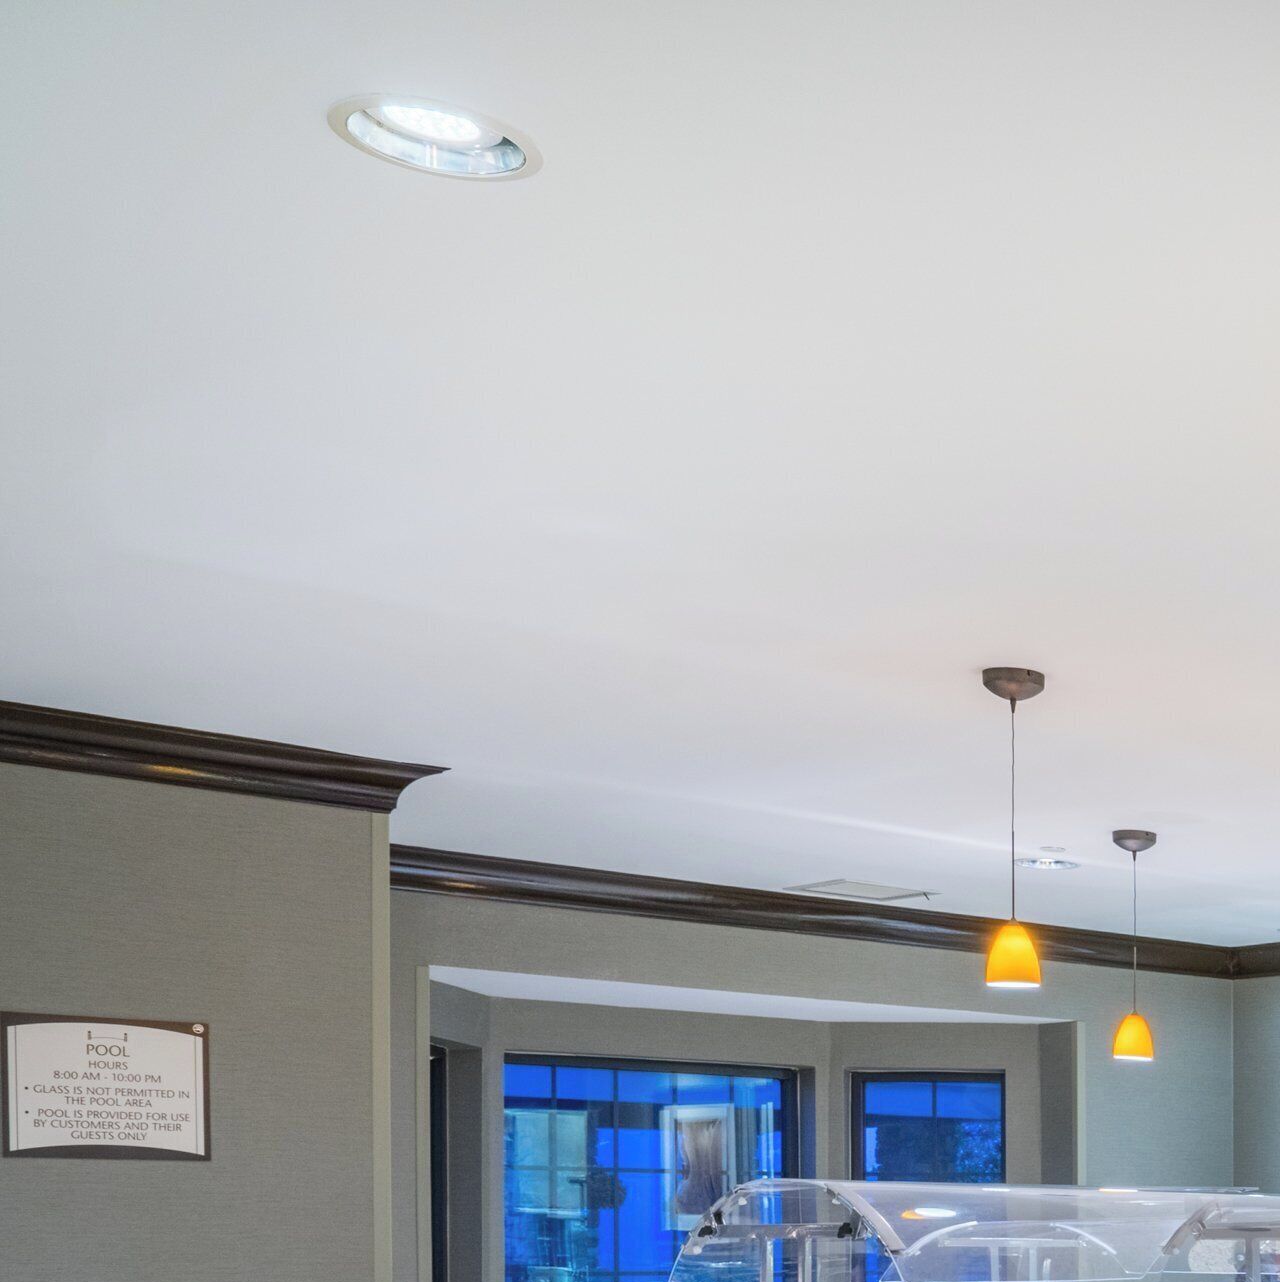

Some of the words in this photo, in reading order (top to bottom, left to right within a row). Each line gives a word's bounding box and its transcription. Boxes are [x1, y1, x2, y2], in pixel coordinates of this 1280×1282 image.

[86, 1043, 131, 1058] POOL
[88, 1060, 129, 1070] HOURS
[53, 1070, 79, 1080] 8:00
[81, 1071, 101, 1081] AM
[112, 1073, 142, 1082] 10:00
[144, 1074, 162, 1083] PM
[33, 1084, 70, 1094] GLASS
[73, 1086, 83, 1095] IS
[86, 1086, 112, 1096] NOT
[114, 1087, 175, 1099] PERMITTED
[178, 1090, 190, 1099] IN
[65, 1096, 86, 1105] THE
[89, 1097, 121, 1106] POOL
[124, 1098, 153, 1108] AREA
[37, 1108, 71, 1118] POOL
[73, 1110, 83, 1119] IS
[86, 1110, 143, 1120] PROVIDED
[146, 1112, 168, 1121] FOR
[170, 1113, 190, 1122] USE
[33, 1119, 48, 1128] BY
[50, 1119, 121, 1130] CUSTOMERS
[124, 1121, 149, 1131] AND
[152, 1122, 182, 1132] THEIR
[71, 1130, 114, 1140] GUESTS
[118, 1131, 148, 1141] ONLY
